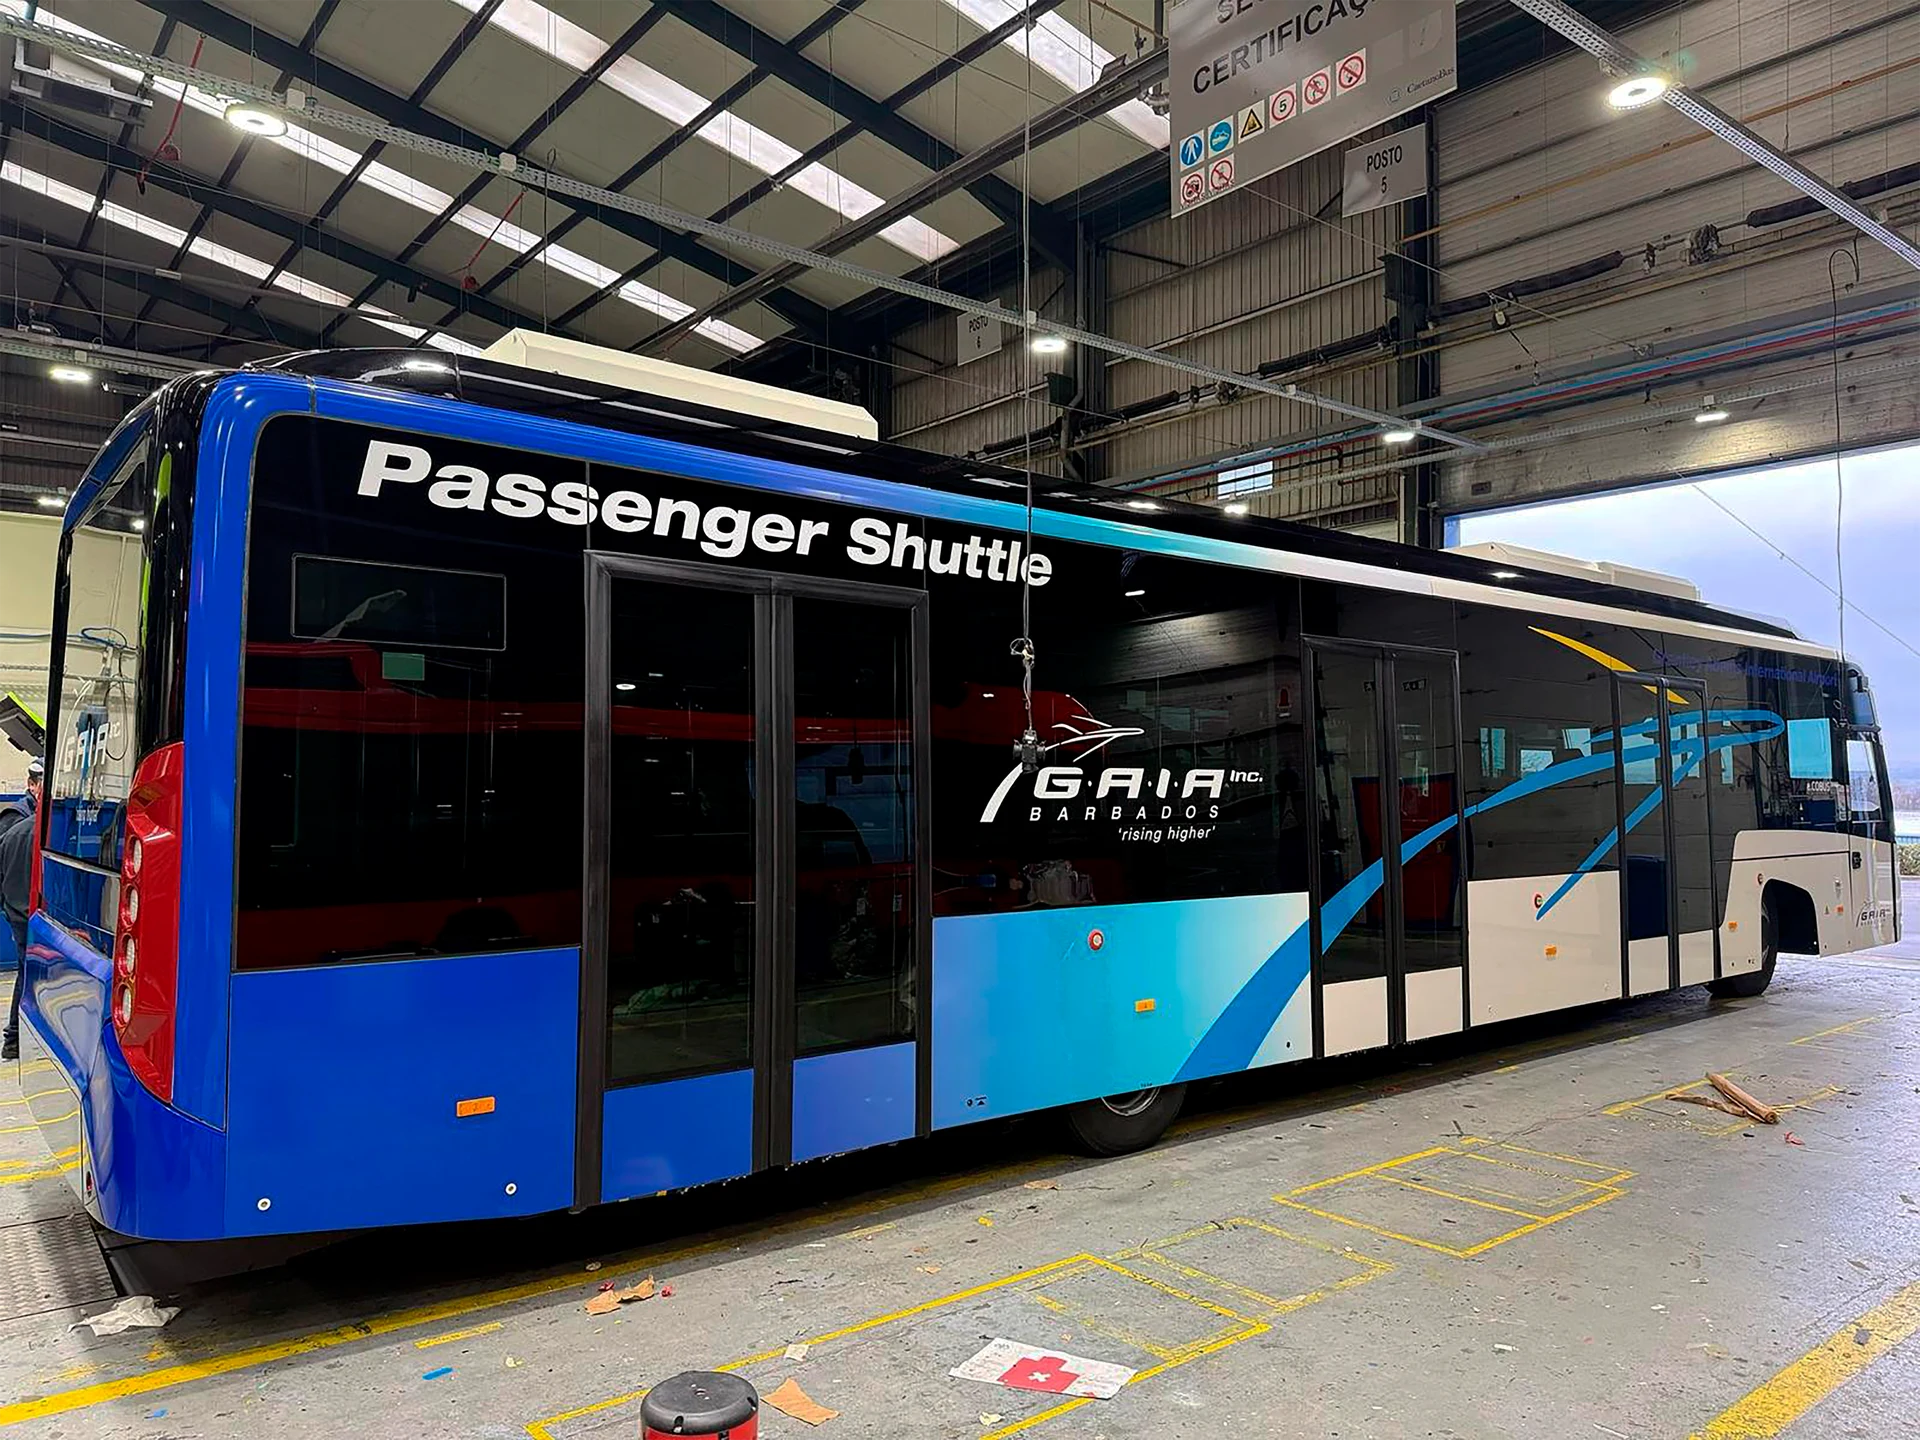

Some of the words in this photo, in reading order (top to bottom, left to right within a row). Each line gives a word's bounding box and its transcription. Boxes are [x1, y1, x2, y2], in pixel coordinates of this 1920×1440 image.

[1279, 99, 1287, 112] 5
[1366, 145, 1403, 173] POSTO
[1380, 176, 1387, 194] 5
[357, 440, 828, 557] Passenger
[846, 517, 1052, 587] Shuttle
[1230, 769, 1264, 783] Inc.
[1029, 805, 1219, 822] BARBADOS
